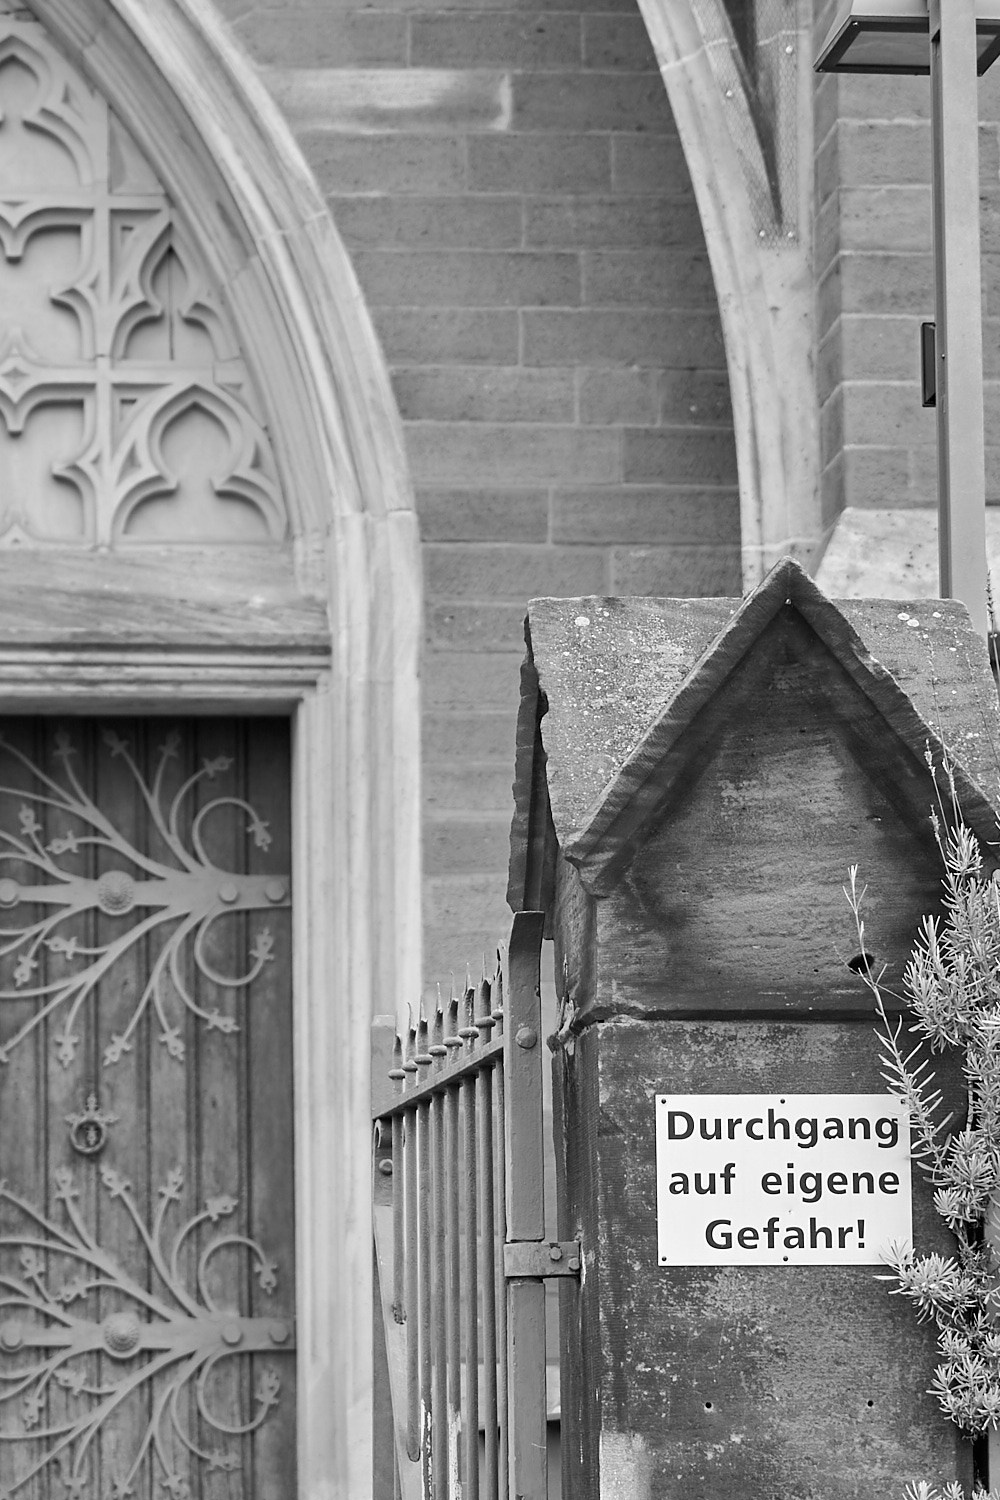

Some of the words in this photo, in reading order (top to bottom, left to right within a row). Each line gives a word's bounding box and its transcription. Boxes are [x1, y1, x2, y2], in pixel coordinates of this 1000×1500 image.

[666, 1108, 899, 1149] Durchgang
[668, 1162, 736, 1195] auf
[761, 1162, 900, 1204] eigene
[705, 1217, 866, 1250] Gefahr!
